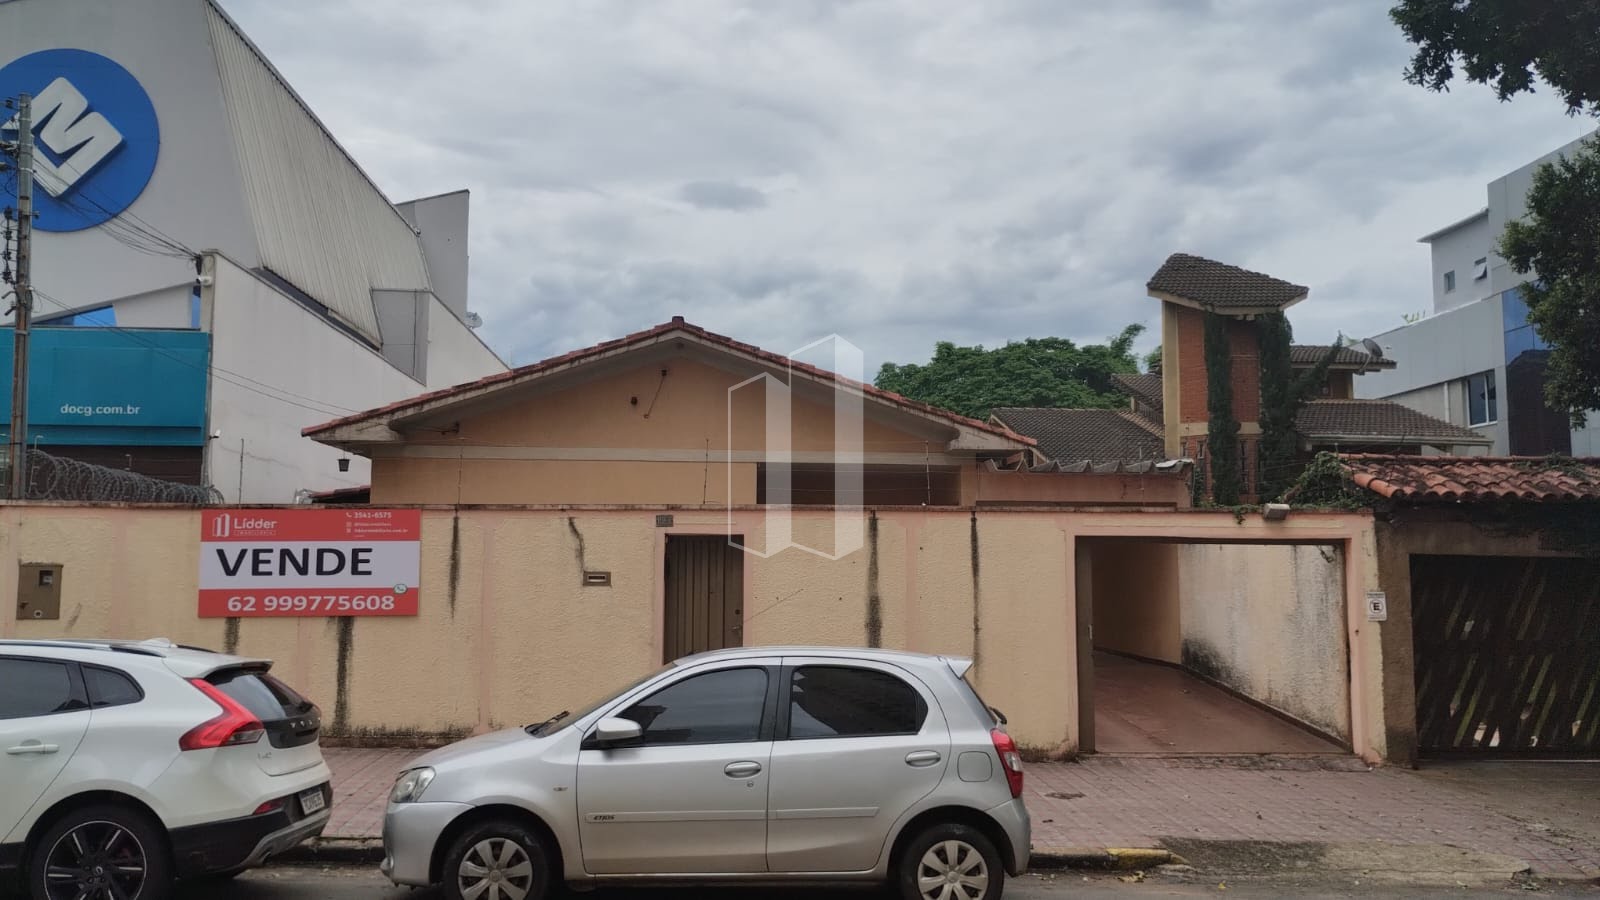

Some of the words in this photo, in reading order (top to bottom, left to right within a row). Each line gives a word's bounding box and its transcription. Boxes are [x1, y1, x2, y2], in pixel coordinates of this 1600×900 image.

[60, 403, 141, 416] docg.com.br
[234, 517, 277, 530] Lídder
[216, 548, 373, 577] VENDE
[227, 596, 256, 612] 62
[263, 595, 395, 612] 999775608
[1373, 602, 1380, 611] E
